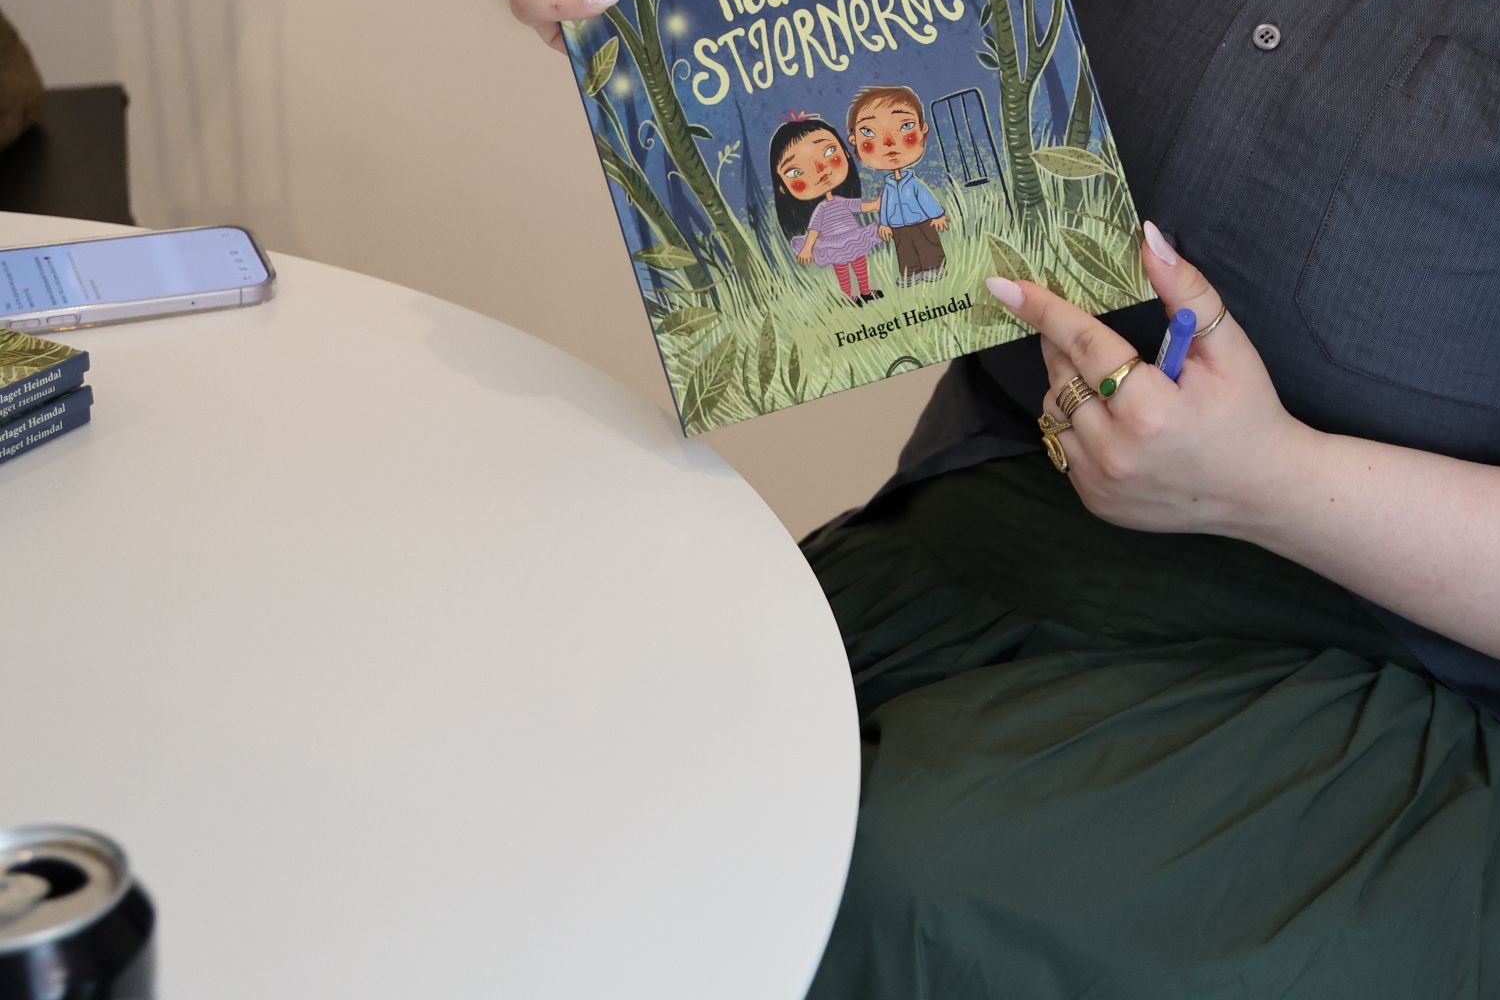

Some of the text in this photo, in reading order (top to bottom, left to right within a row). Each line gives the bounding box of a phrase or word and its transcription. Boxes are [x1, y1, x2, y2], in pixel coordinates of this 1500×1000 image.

[835, 293, 974, 348] Forlaget Heimdal
[23, 368, 62, 393] Heimdal
[28, 403, 66, 428] Heimdal
[26, 420, 63, 445] Heimdal
